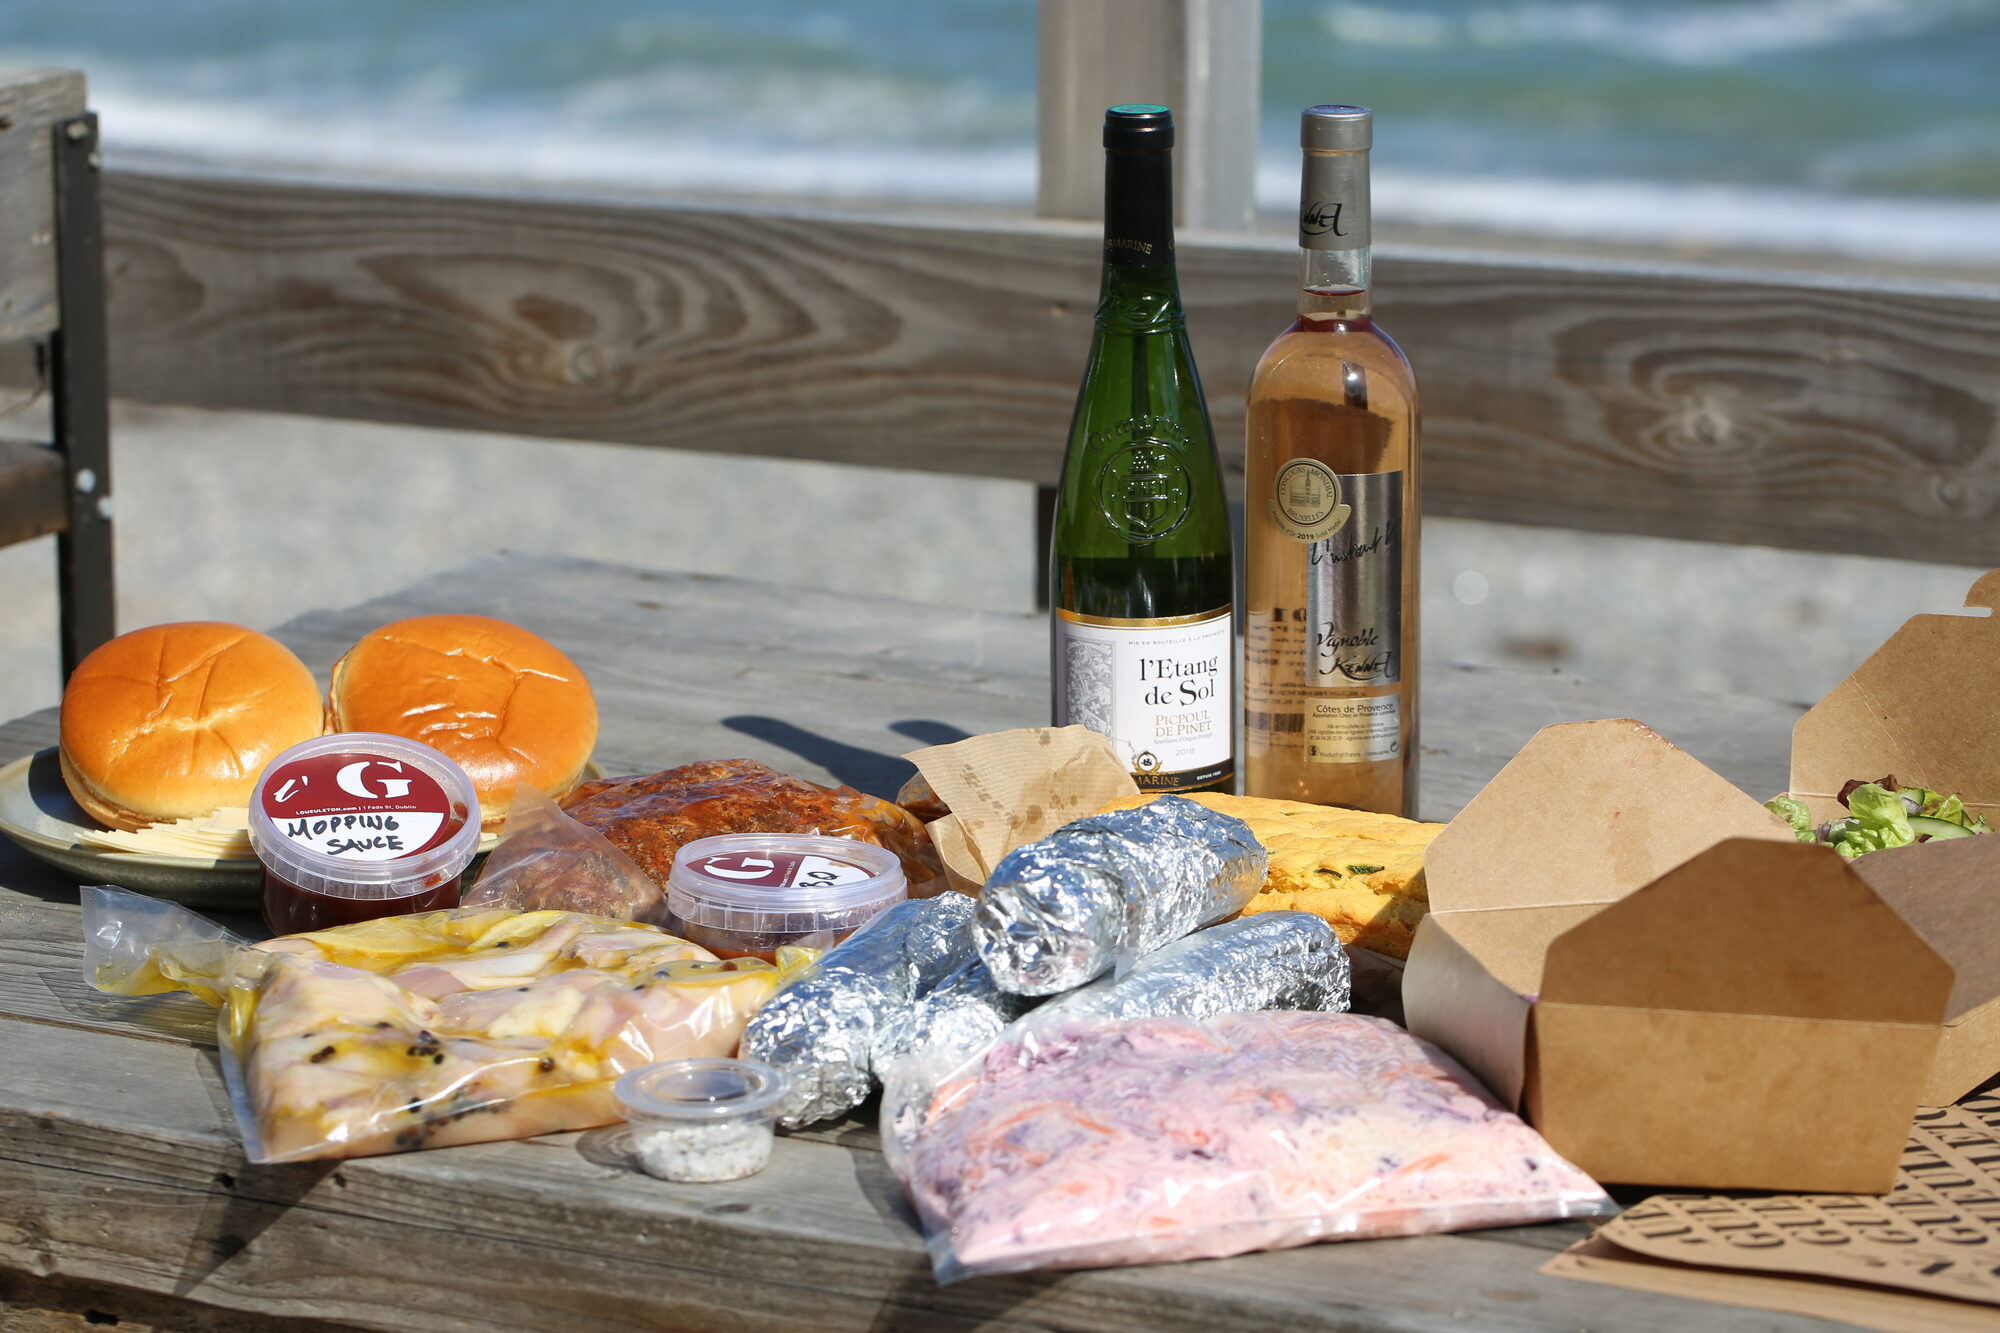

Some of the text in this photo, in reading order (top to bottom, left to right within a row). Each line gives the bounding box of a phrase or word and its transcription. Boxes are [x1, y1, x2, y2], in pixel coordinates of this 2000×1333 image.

[1138, 656, 1218, 681] l'Etang
[1144, 678, 1214, 706] de Sol
[1155, 710, 1210, 726] PICPOUL
[1316, 704, 1340, 713] Côtes
[1358, 704, 1394, 712] Provence
[1156, 720, 1212, 738] DE PINET
[288, 814, 400, 840] MOPPING
[326, 835, 404, 856] SAUCE
